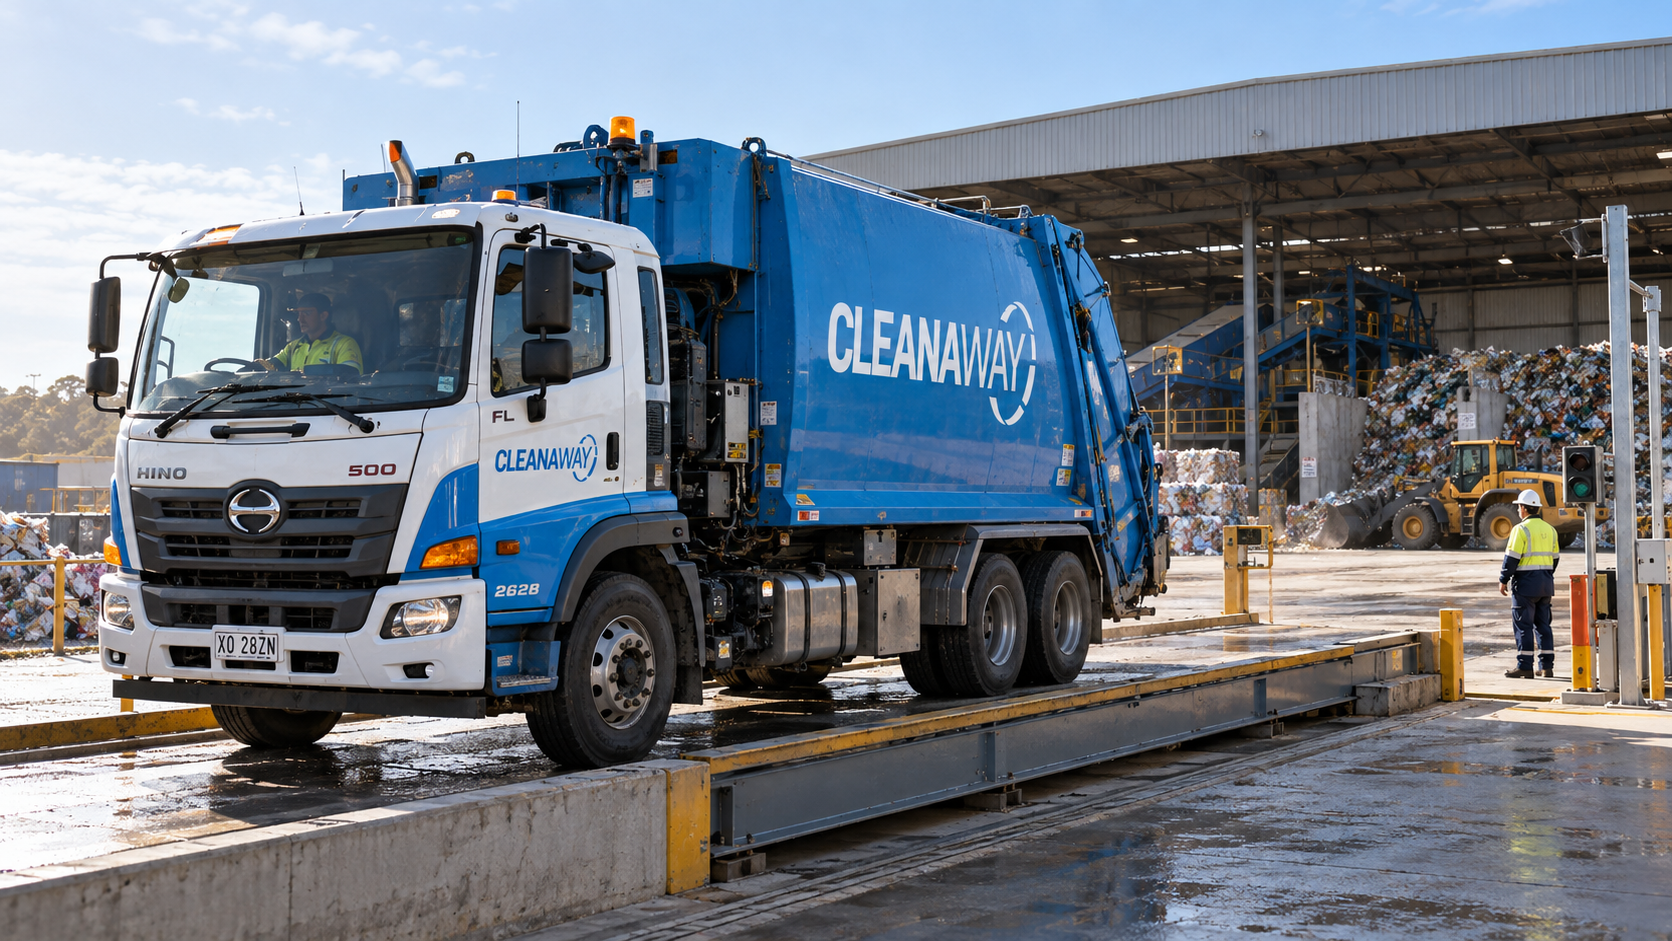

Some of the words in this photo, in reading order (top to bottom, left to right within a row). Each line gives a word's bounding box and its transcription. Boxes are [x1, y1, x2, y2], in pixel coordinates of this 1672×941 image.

[828, 302, 1026, 392] CLEANAWAY
[492, 410, 515, 423] FL
[495, 446, 593, 473] CLEANAWAY
[137, 467, 187, 480] HINO
[348, 463, 397, 477] 500
[241, 635, 276, 655] 28ZN
